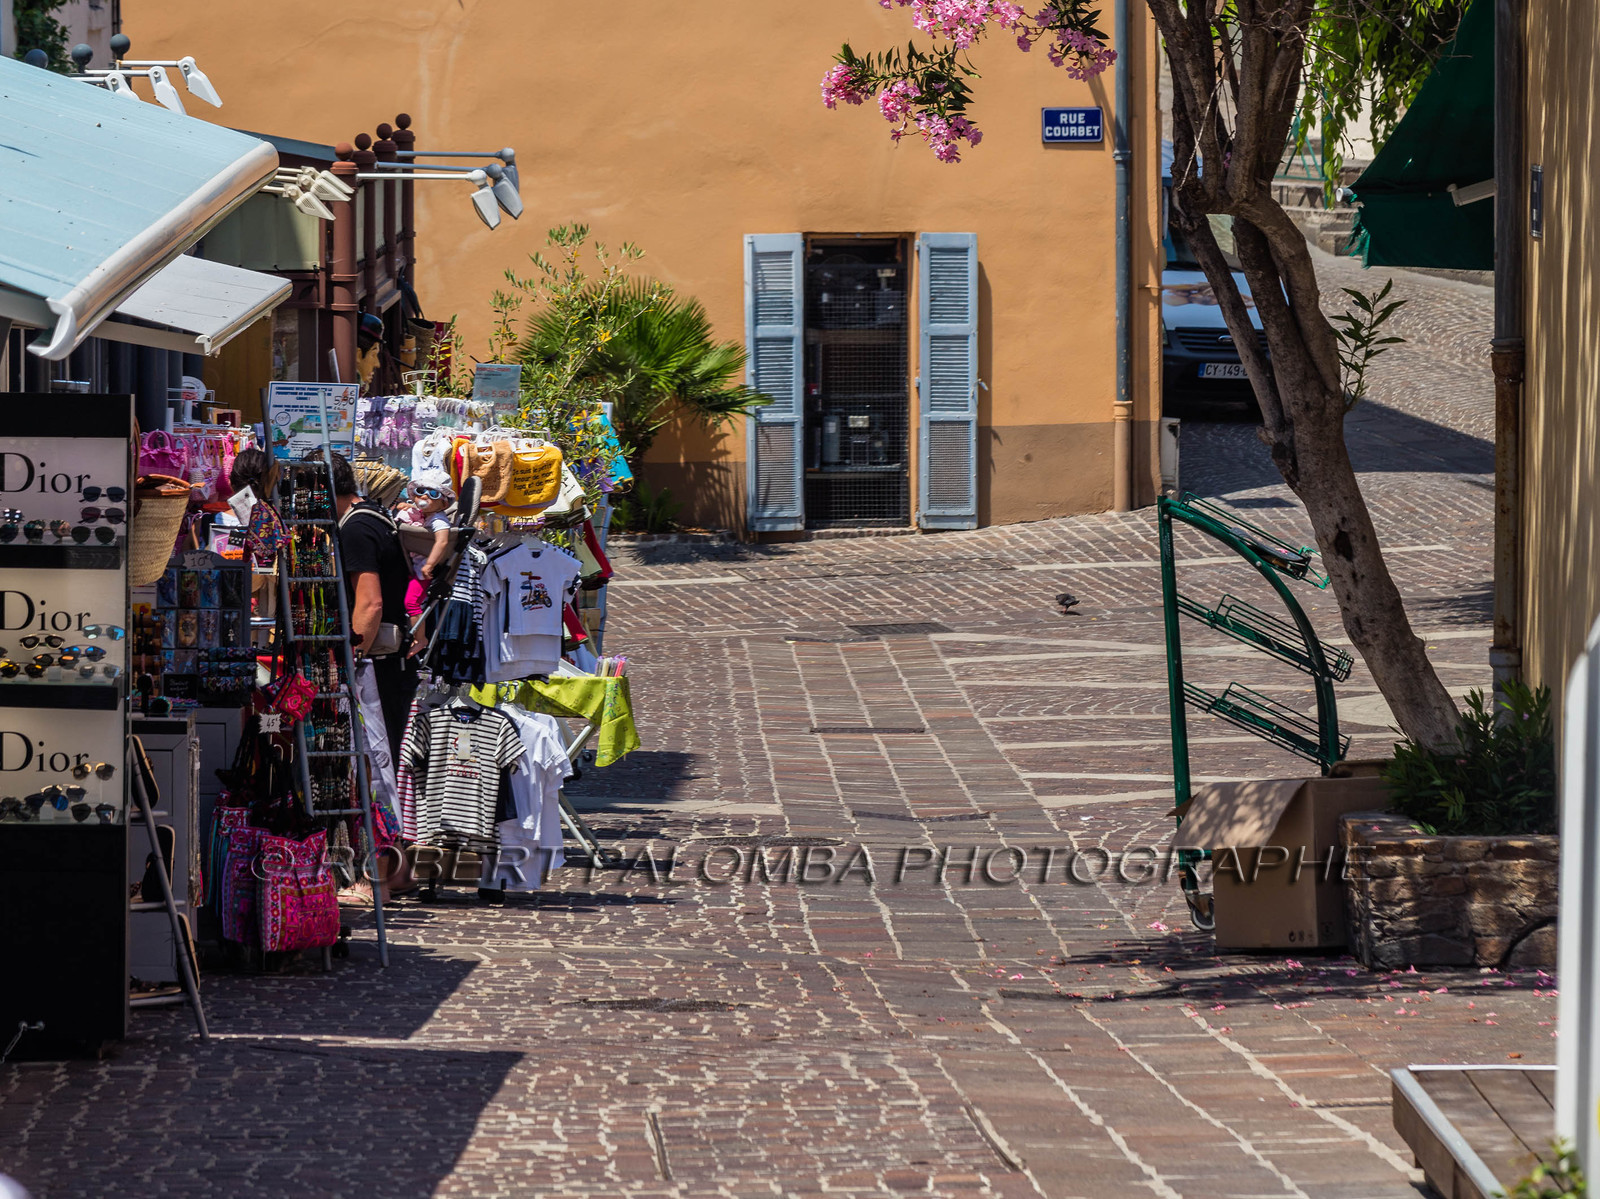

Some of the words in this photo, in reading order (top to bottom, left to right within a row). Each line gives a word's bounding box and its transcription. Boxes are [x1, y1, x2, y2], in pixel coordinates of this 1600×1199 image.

[1045, 126, 1100, 137] COURBET
[1060, 113, 1085, 124] RUE
[0, 452, 91, 493] Dior
[520, 467, 531, 475] suis
[0, 590, 91, 631] Dior
[0, 731, 89, 772] Dior
